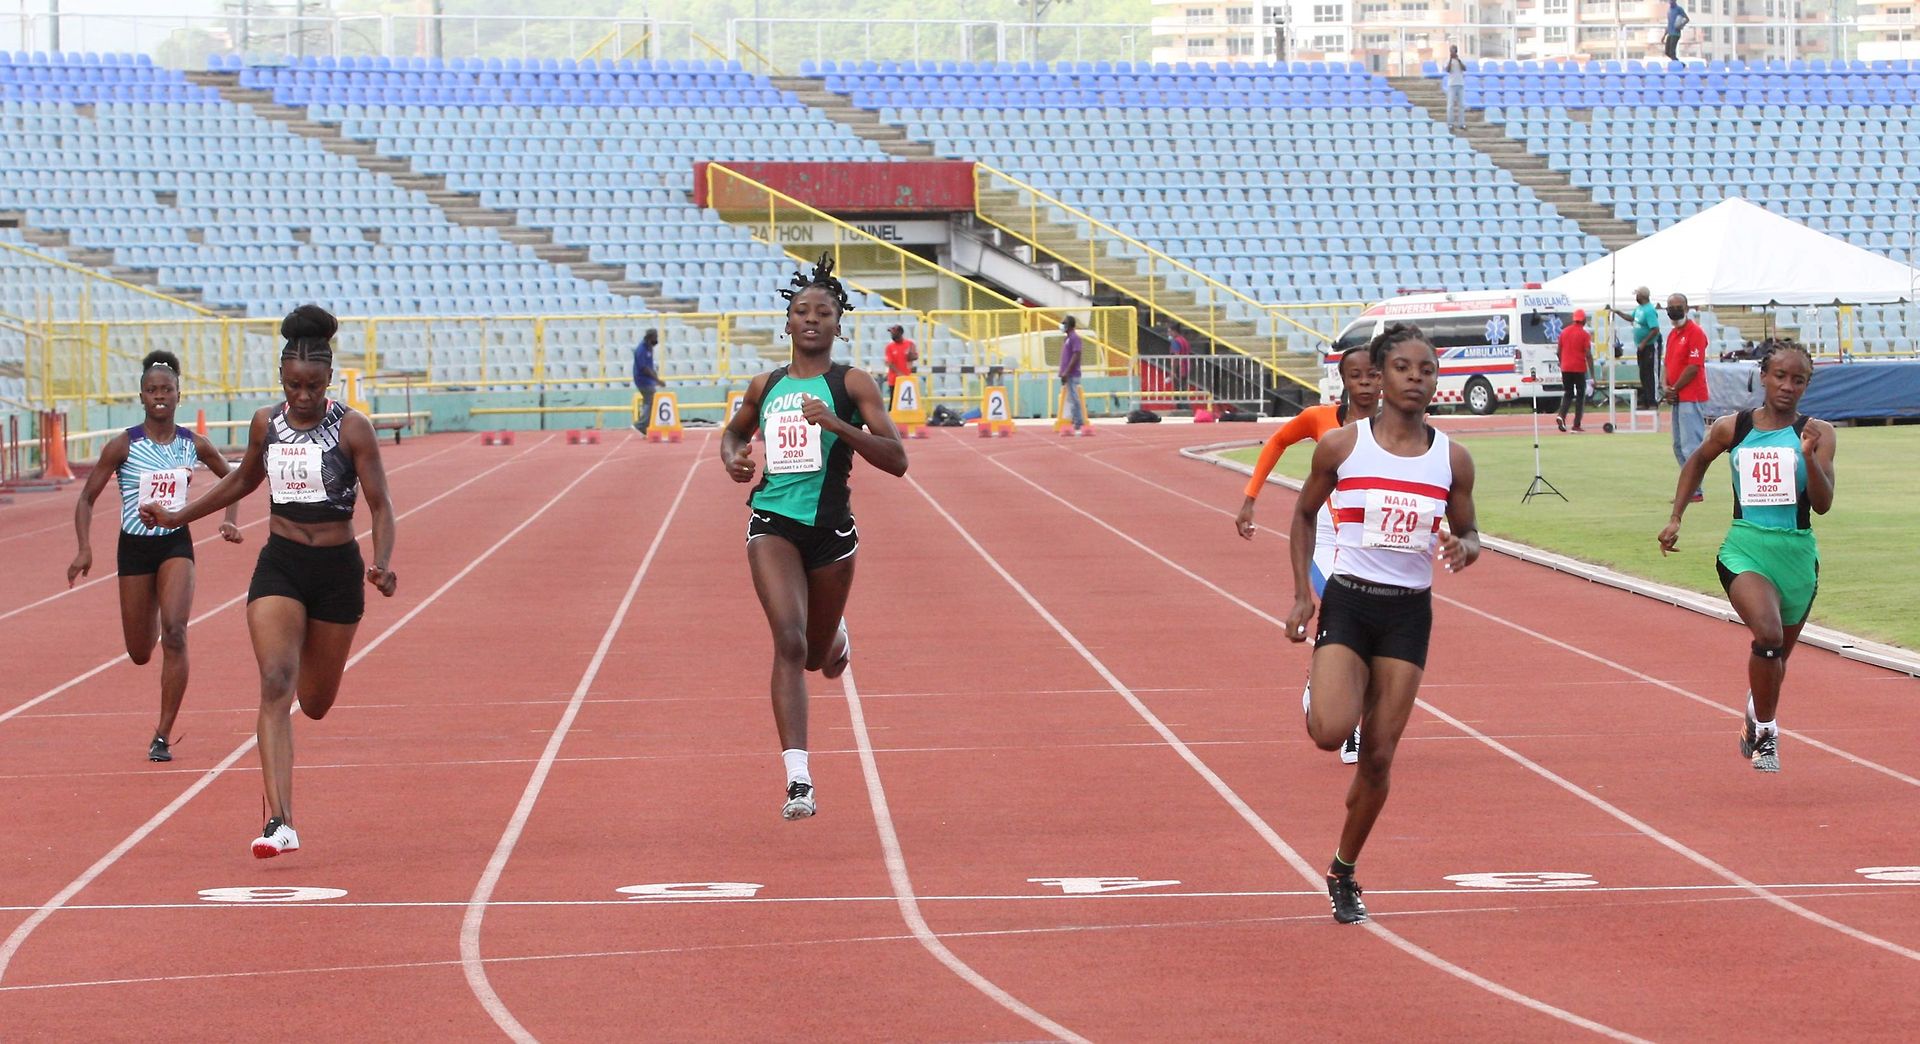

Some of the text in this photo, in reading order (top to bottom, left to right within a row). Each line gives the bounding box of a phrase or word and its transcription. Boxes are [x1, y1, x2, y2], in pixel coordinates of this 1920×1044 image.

[1524, 296, 1571, 306] AMBULANCE
[1385, 304, 1436, 315] UNIVERSAL
[1464, 347, 1514, 358] AMBULANCE
[901, 386, 914, 405] 4
[659, 402, 671, 421] 6
[991, 396, 1002, 416] 2
[780, 415, 805, 423] NAAA
[778, 425, 808, 449] 503
[281, 447, 307, 456] NAAA
[783, 450, 804, 459] 2020
[1753, 452, 1779, 460] NAAA
[278, 460, 308, 480] 715
[1752, 462, 1782, 483] 491
[151, 481, 176, 498] 794
[285, 482, 307, 490] 2020
[1384, 495, 1417, 507] NAAA
[1381, 507, 1419, 533] 720
[1384, 534, 1410, 544] 2020
